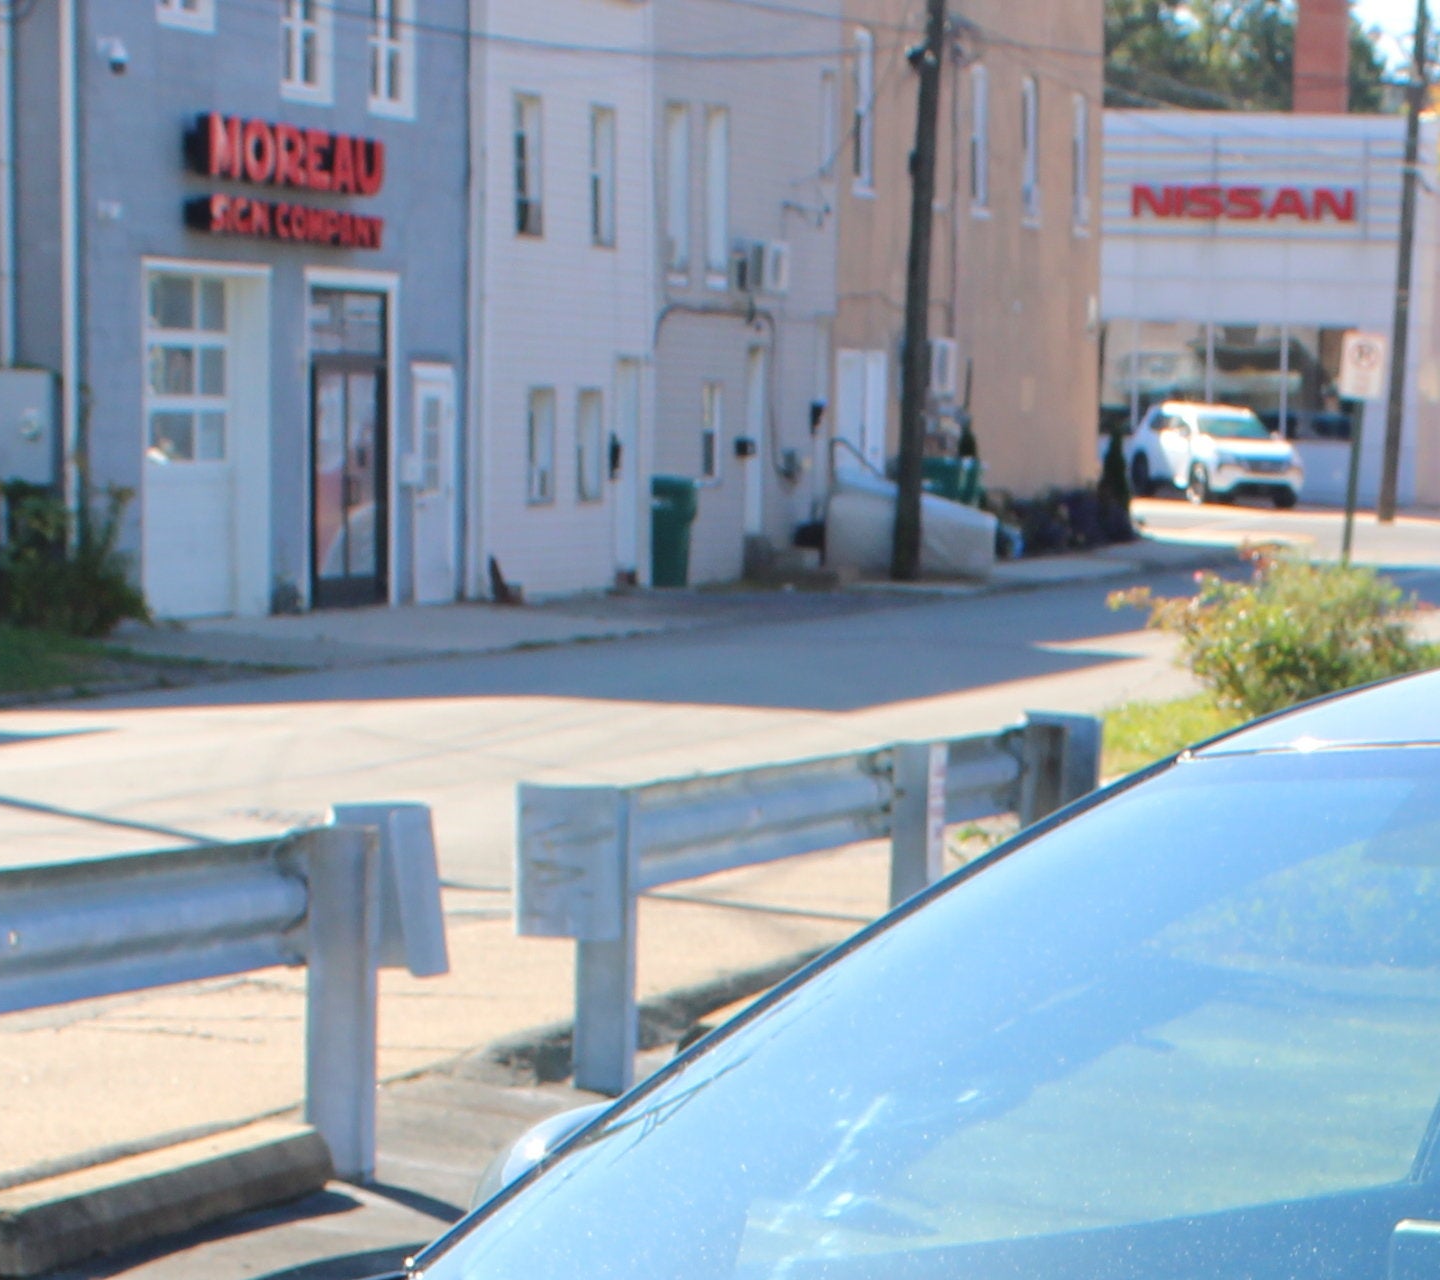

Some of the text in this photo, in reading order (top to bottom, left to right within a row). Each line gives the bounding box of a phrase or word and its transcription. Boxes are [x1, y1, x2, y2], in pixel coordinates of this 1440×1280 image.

[210, 112, 385, 196] MOREAU
[1131, 184, 1355, 221] NISSAN
[275, 203, 383, 249] COMPANY
